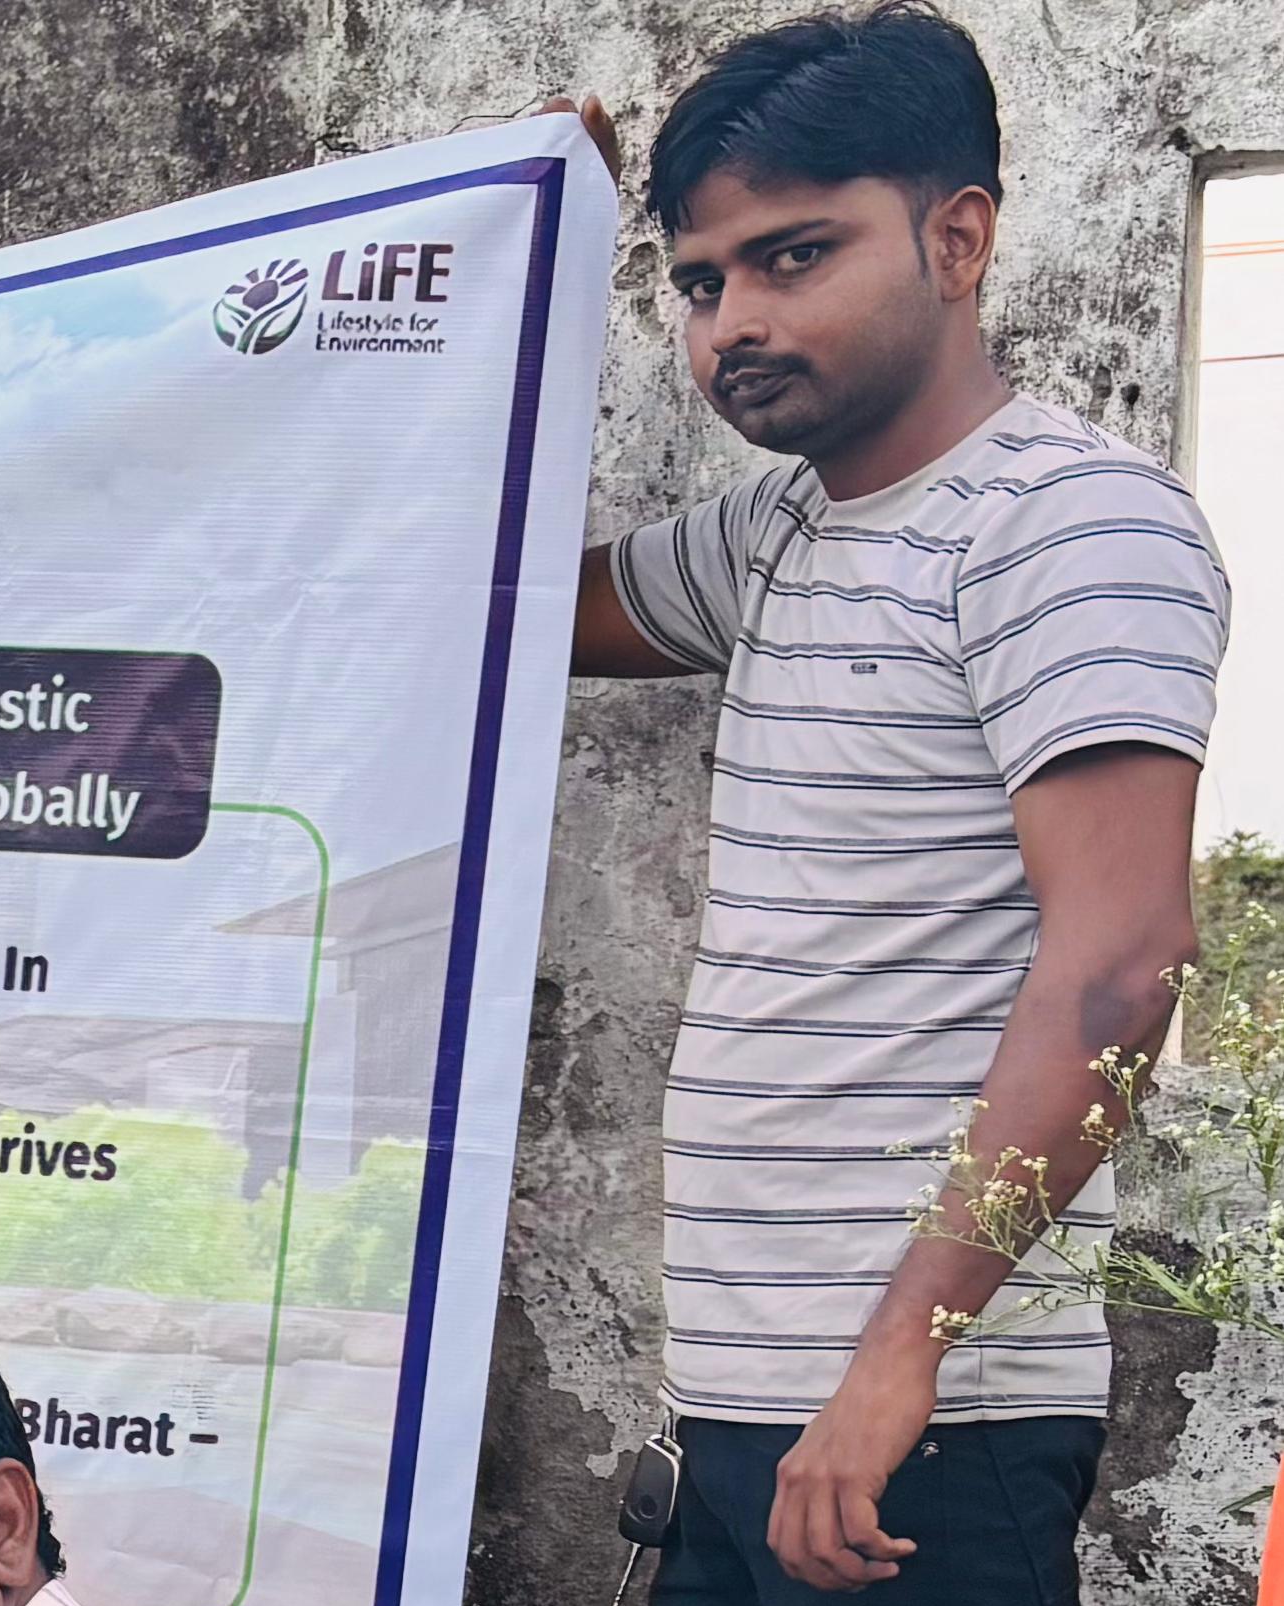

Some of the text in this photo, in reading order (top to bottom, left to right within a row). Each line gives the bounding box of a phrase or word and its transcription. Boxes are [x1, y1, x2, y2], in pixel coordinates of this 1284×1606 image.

[321, 242, 453, 302] LiFE
[315, 334, 446, 353] Environment
[317, 311, 439, 333] Lifestyle for
[3, 946, 50, 992] In
[14, 1397, 176, 1457] Bharat
